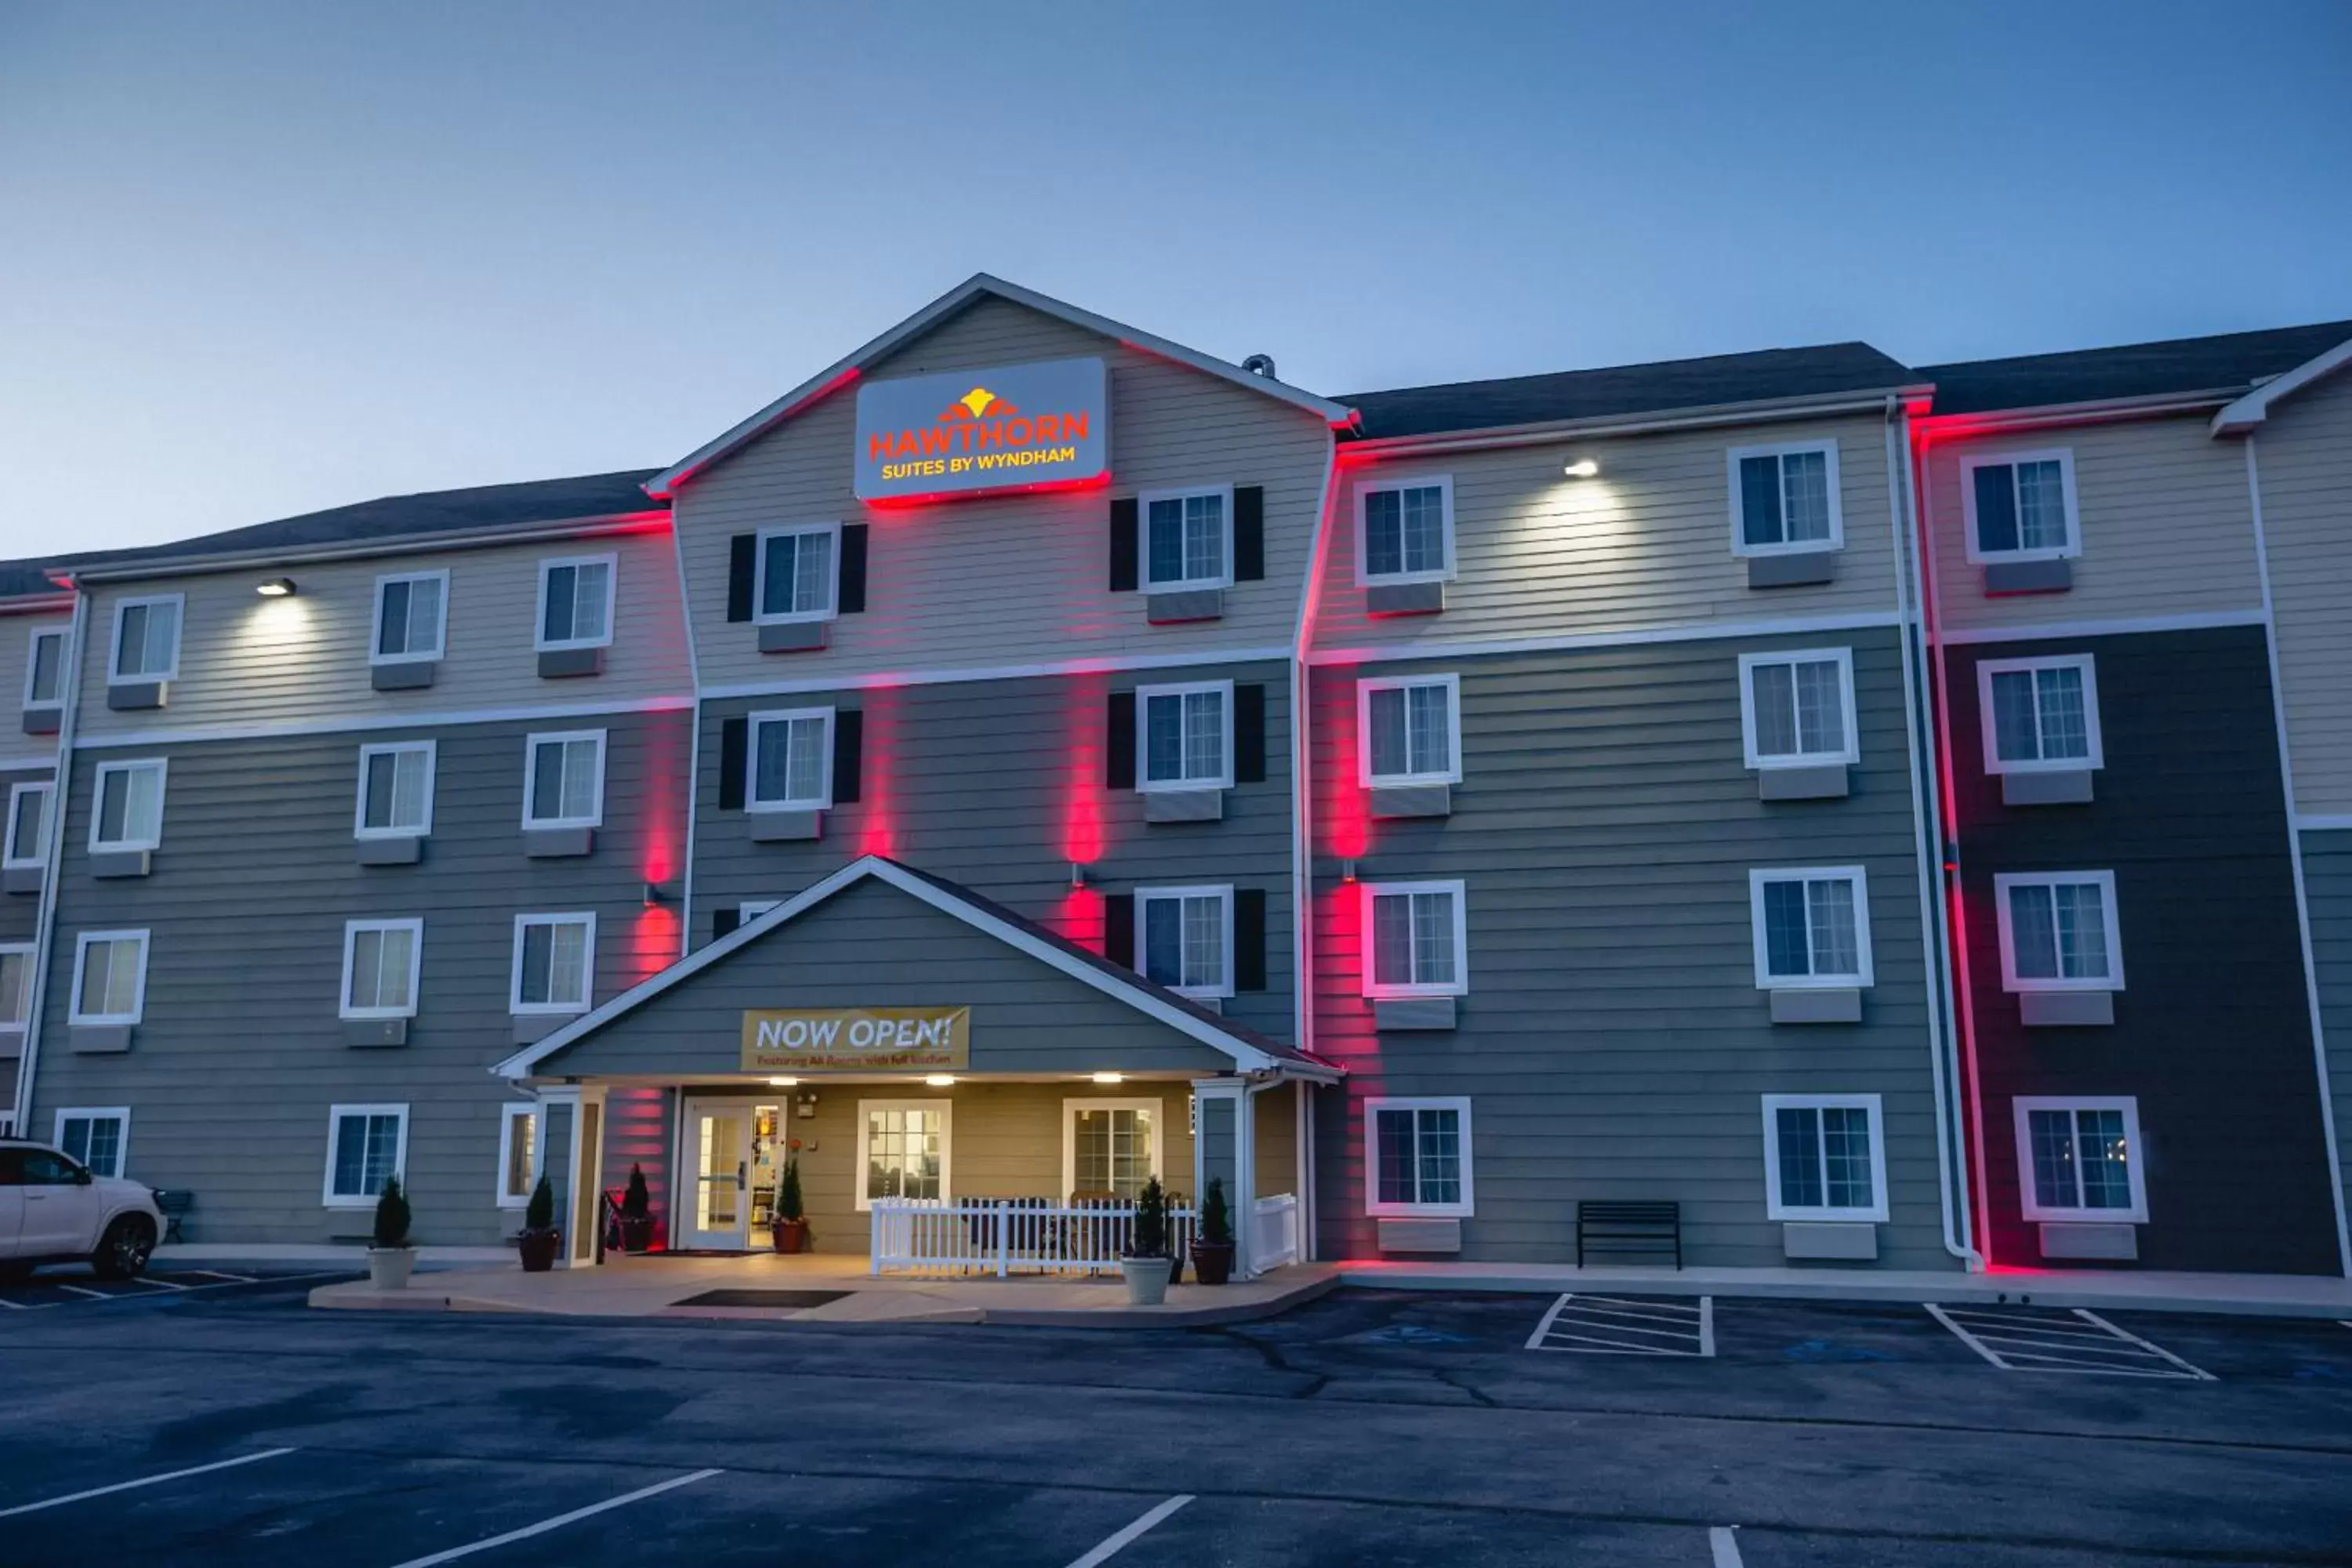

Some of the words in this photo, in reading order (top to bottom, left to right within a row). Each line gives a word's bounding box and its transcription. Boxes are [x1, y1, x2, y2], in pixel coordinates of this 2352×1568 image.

[869, 411, 1090, 463] HAWTHORN
[881, 459, 946, 480] SUITES
[949, 456, 974, 474] BY
[977, 446, 1076, 470] WYNDHAM
[757, 1020, 841, 1049] NOW
[848, 1017, 952, 1047] OPEN!
